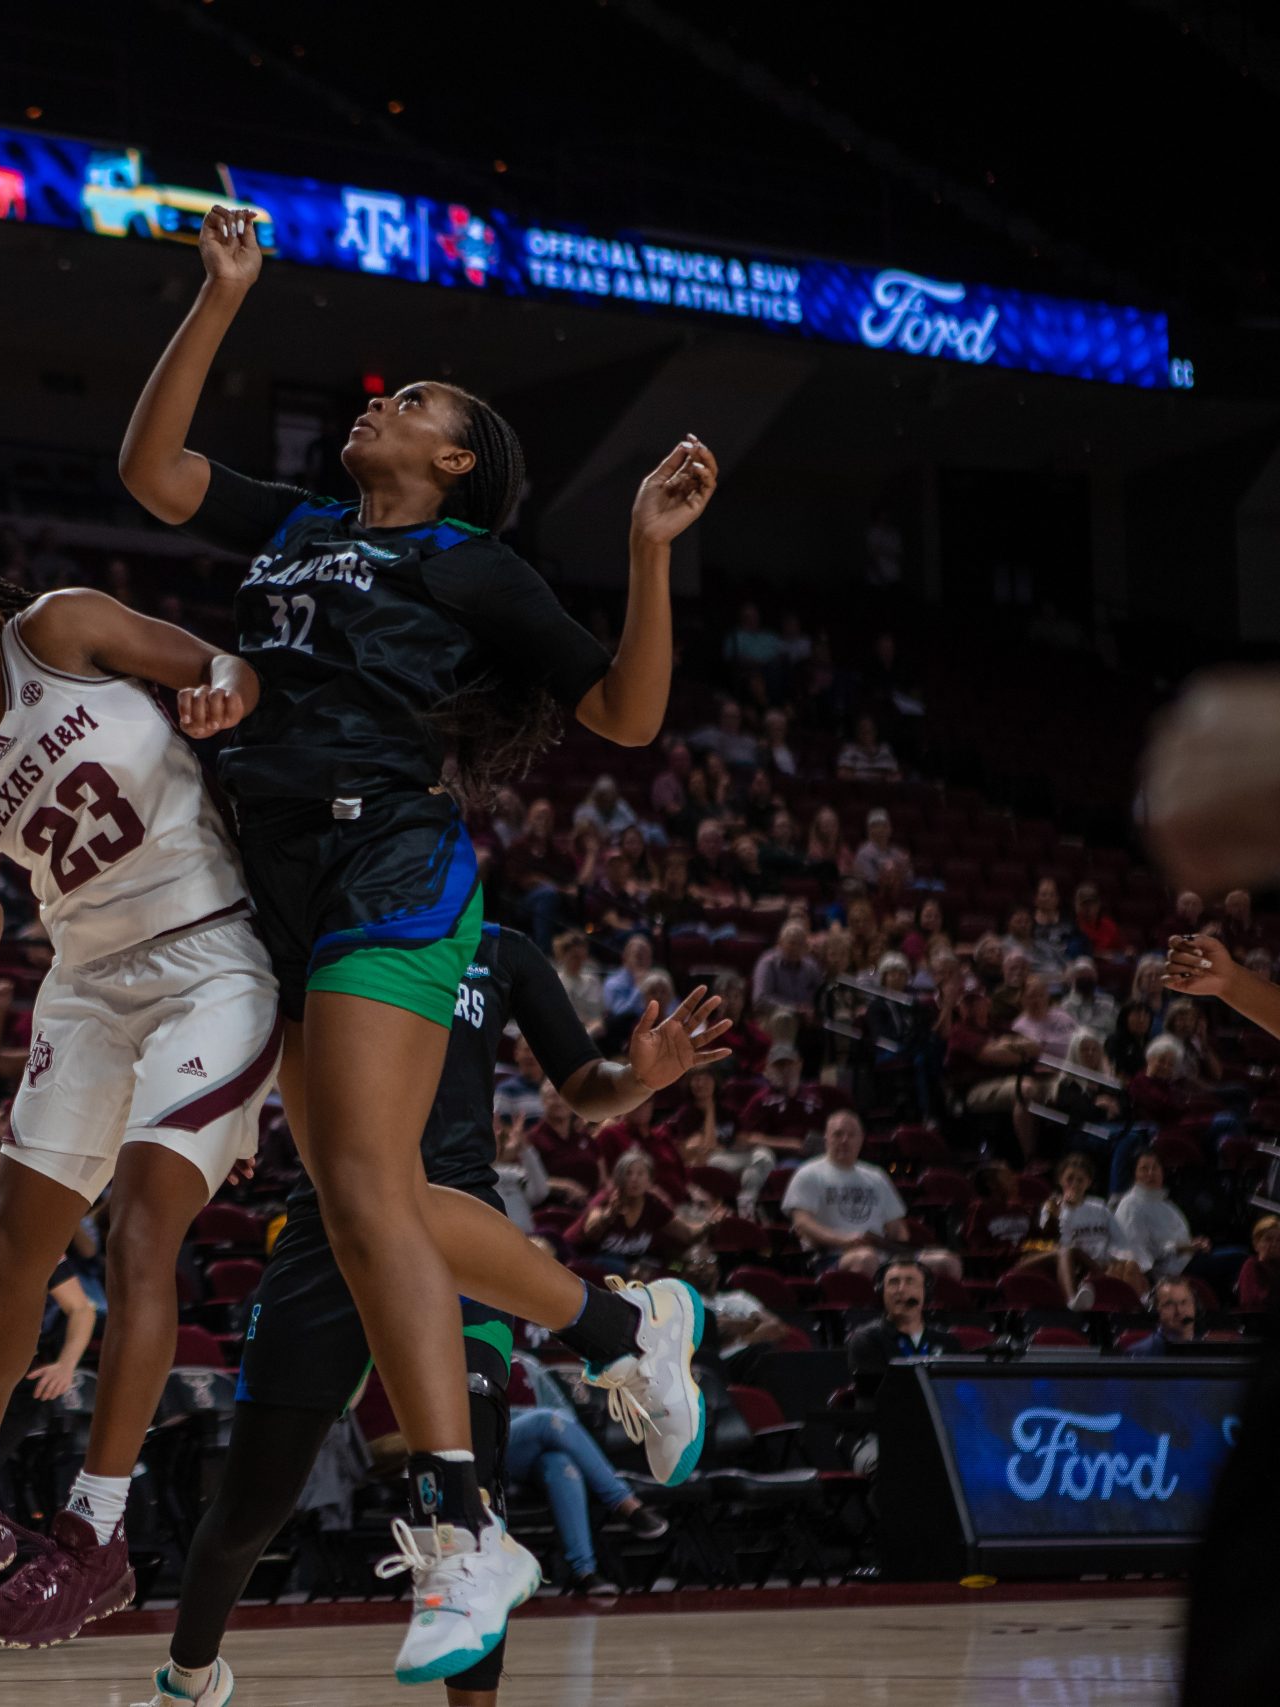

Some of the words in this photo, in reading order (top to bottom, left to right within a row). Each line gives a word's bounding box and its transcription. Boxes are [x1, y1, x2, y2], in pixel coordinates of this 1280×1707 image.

[524, 227, 637, 273] OFFICIAL
[639, 243, 725, 286] TRUCK
[727, 257, 748, 288] &
[749, 260, 801, 295] SUV
[526, 256, 610, 296] TEXAS
[611, 268, 672, 306] A&M
[673, 279, 803, 325] ATHLETICS
[858, 267, 998, 365] Ford
[262, 593, 315, 654] 32
[22, 682, 42, 704] SEC
[37, 704, 99, 764] A&M
[21, 761, 146, 896] 23
[177, 1066, 208, 1078] adidas
[1006, 1406, 1180, 1501] Ford
